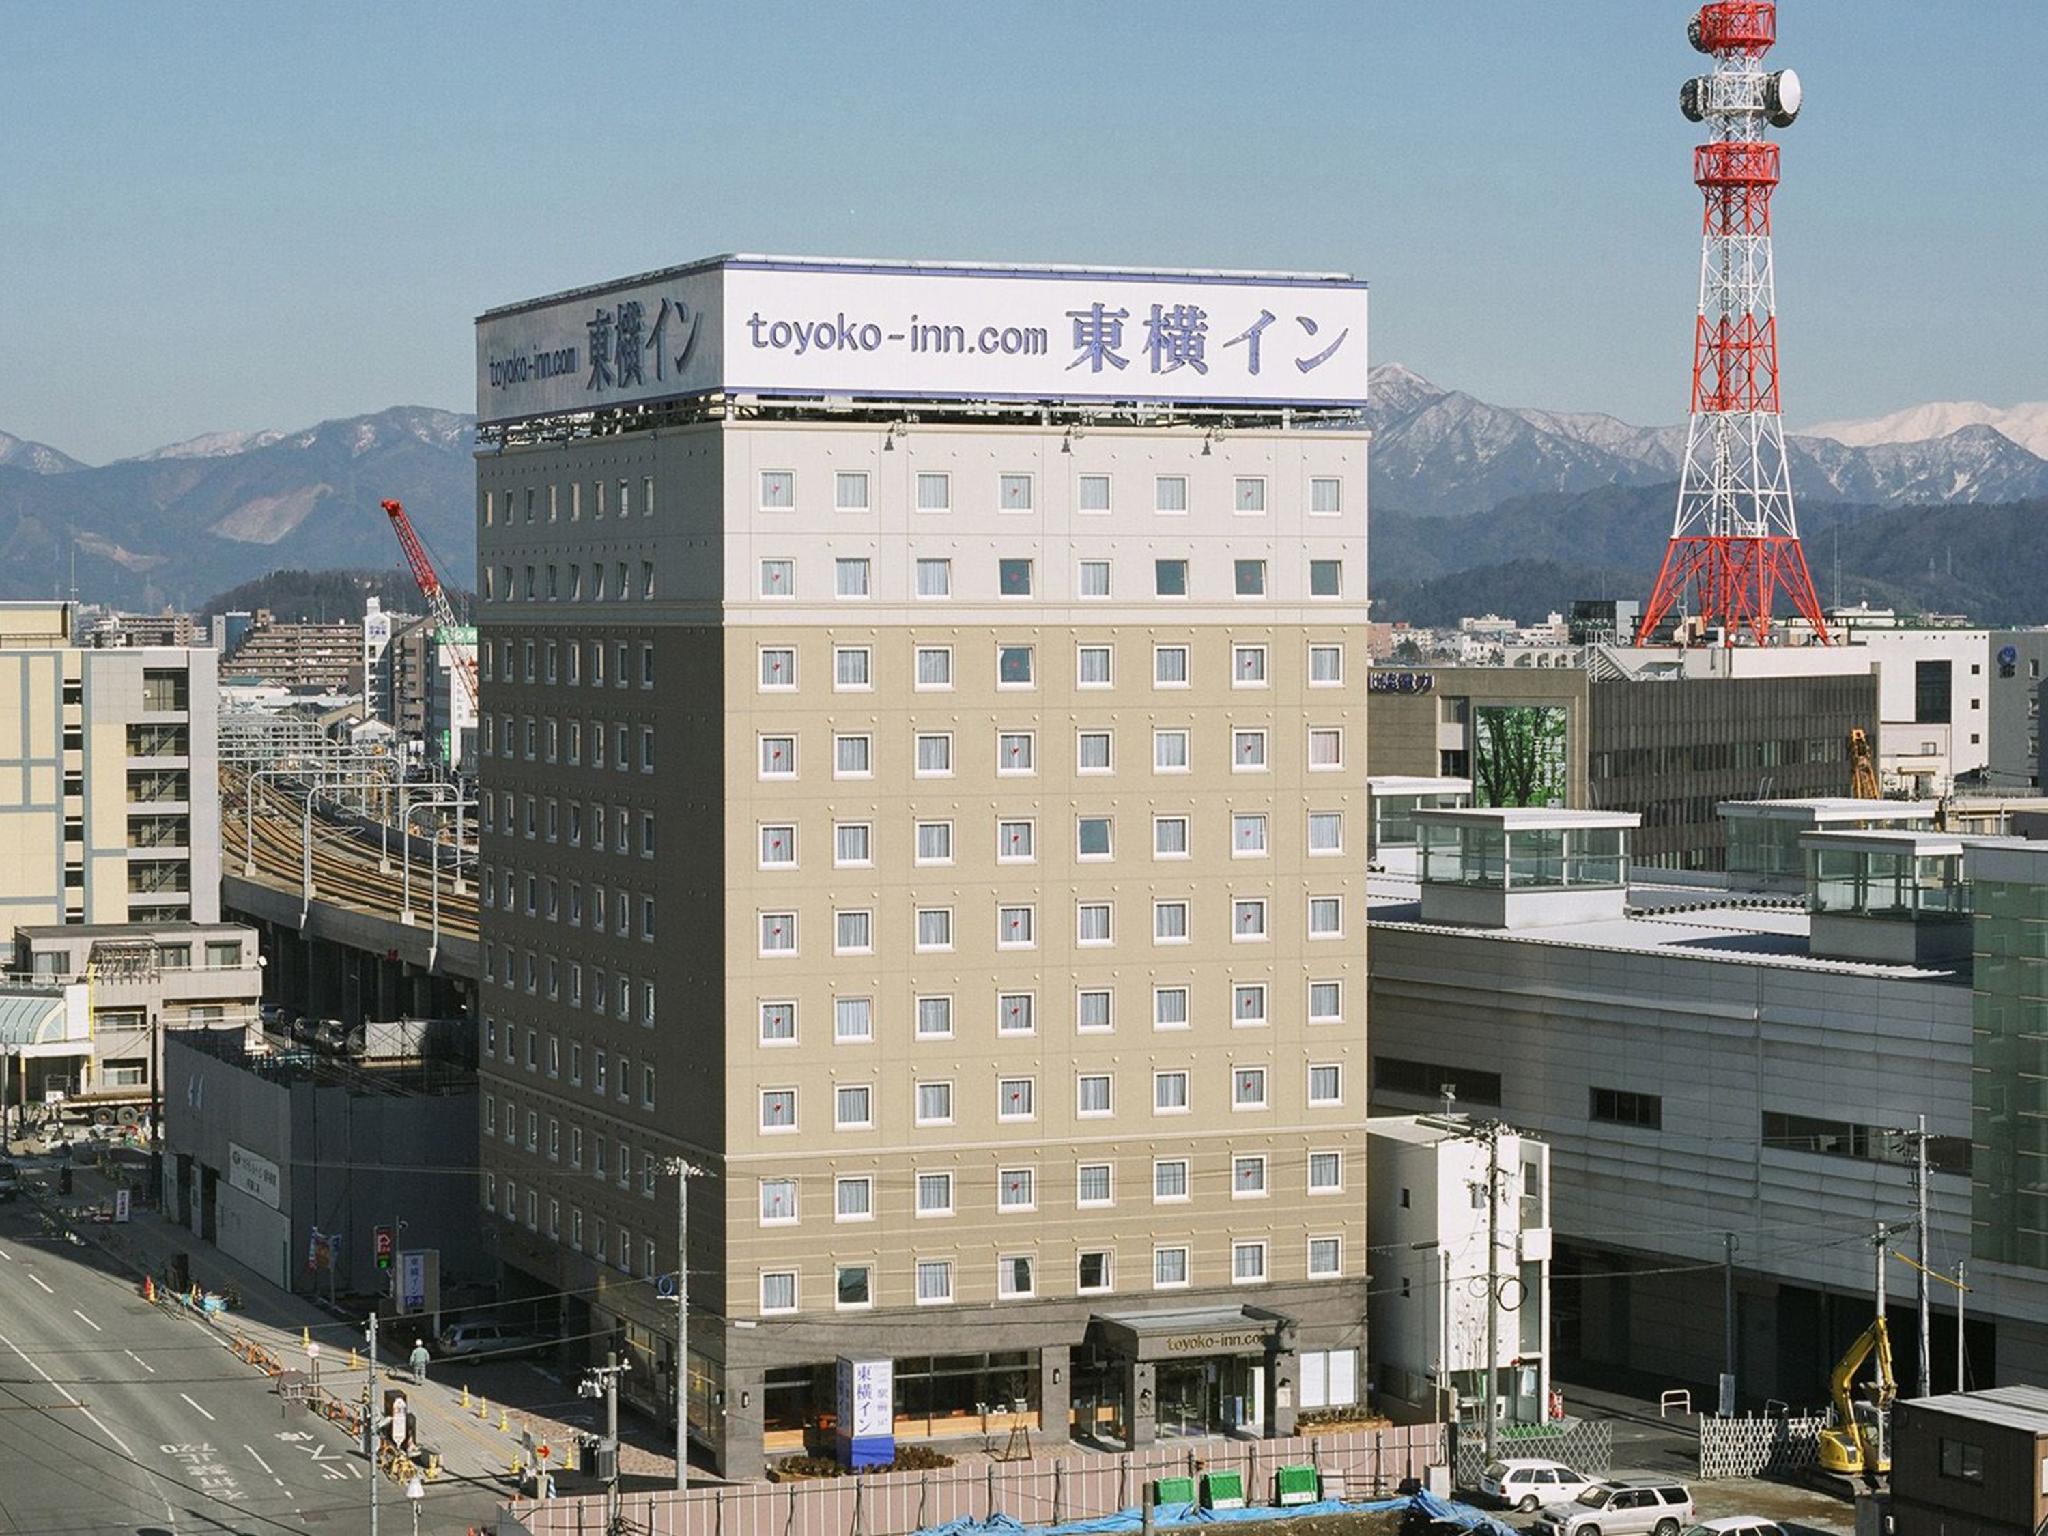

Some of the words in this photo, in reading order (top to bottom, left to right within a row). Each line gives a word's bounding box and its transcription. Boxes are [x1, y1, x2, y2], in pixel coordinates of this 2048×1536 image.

[586, 297, 703, 391] 東横イン
[747, 312, 1049, 355] toyoko-inn.com
[1065, 302, 1349, 375] 東横イン
[489, 344, 576, 390] toyoko-inn.com
[1166, 1333, 1266, 1352] toyoko-inn.co
[857, 1365, 872, 1433] 東横イン
